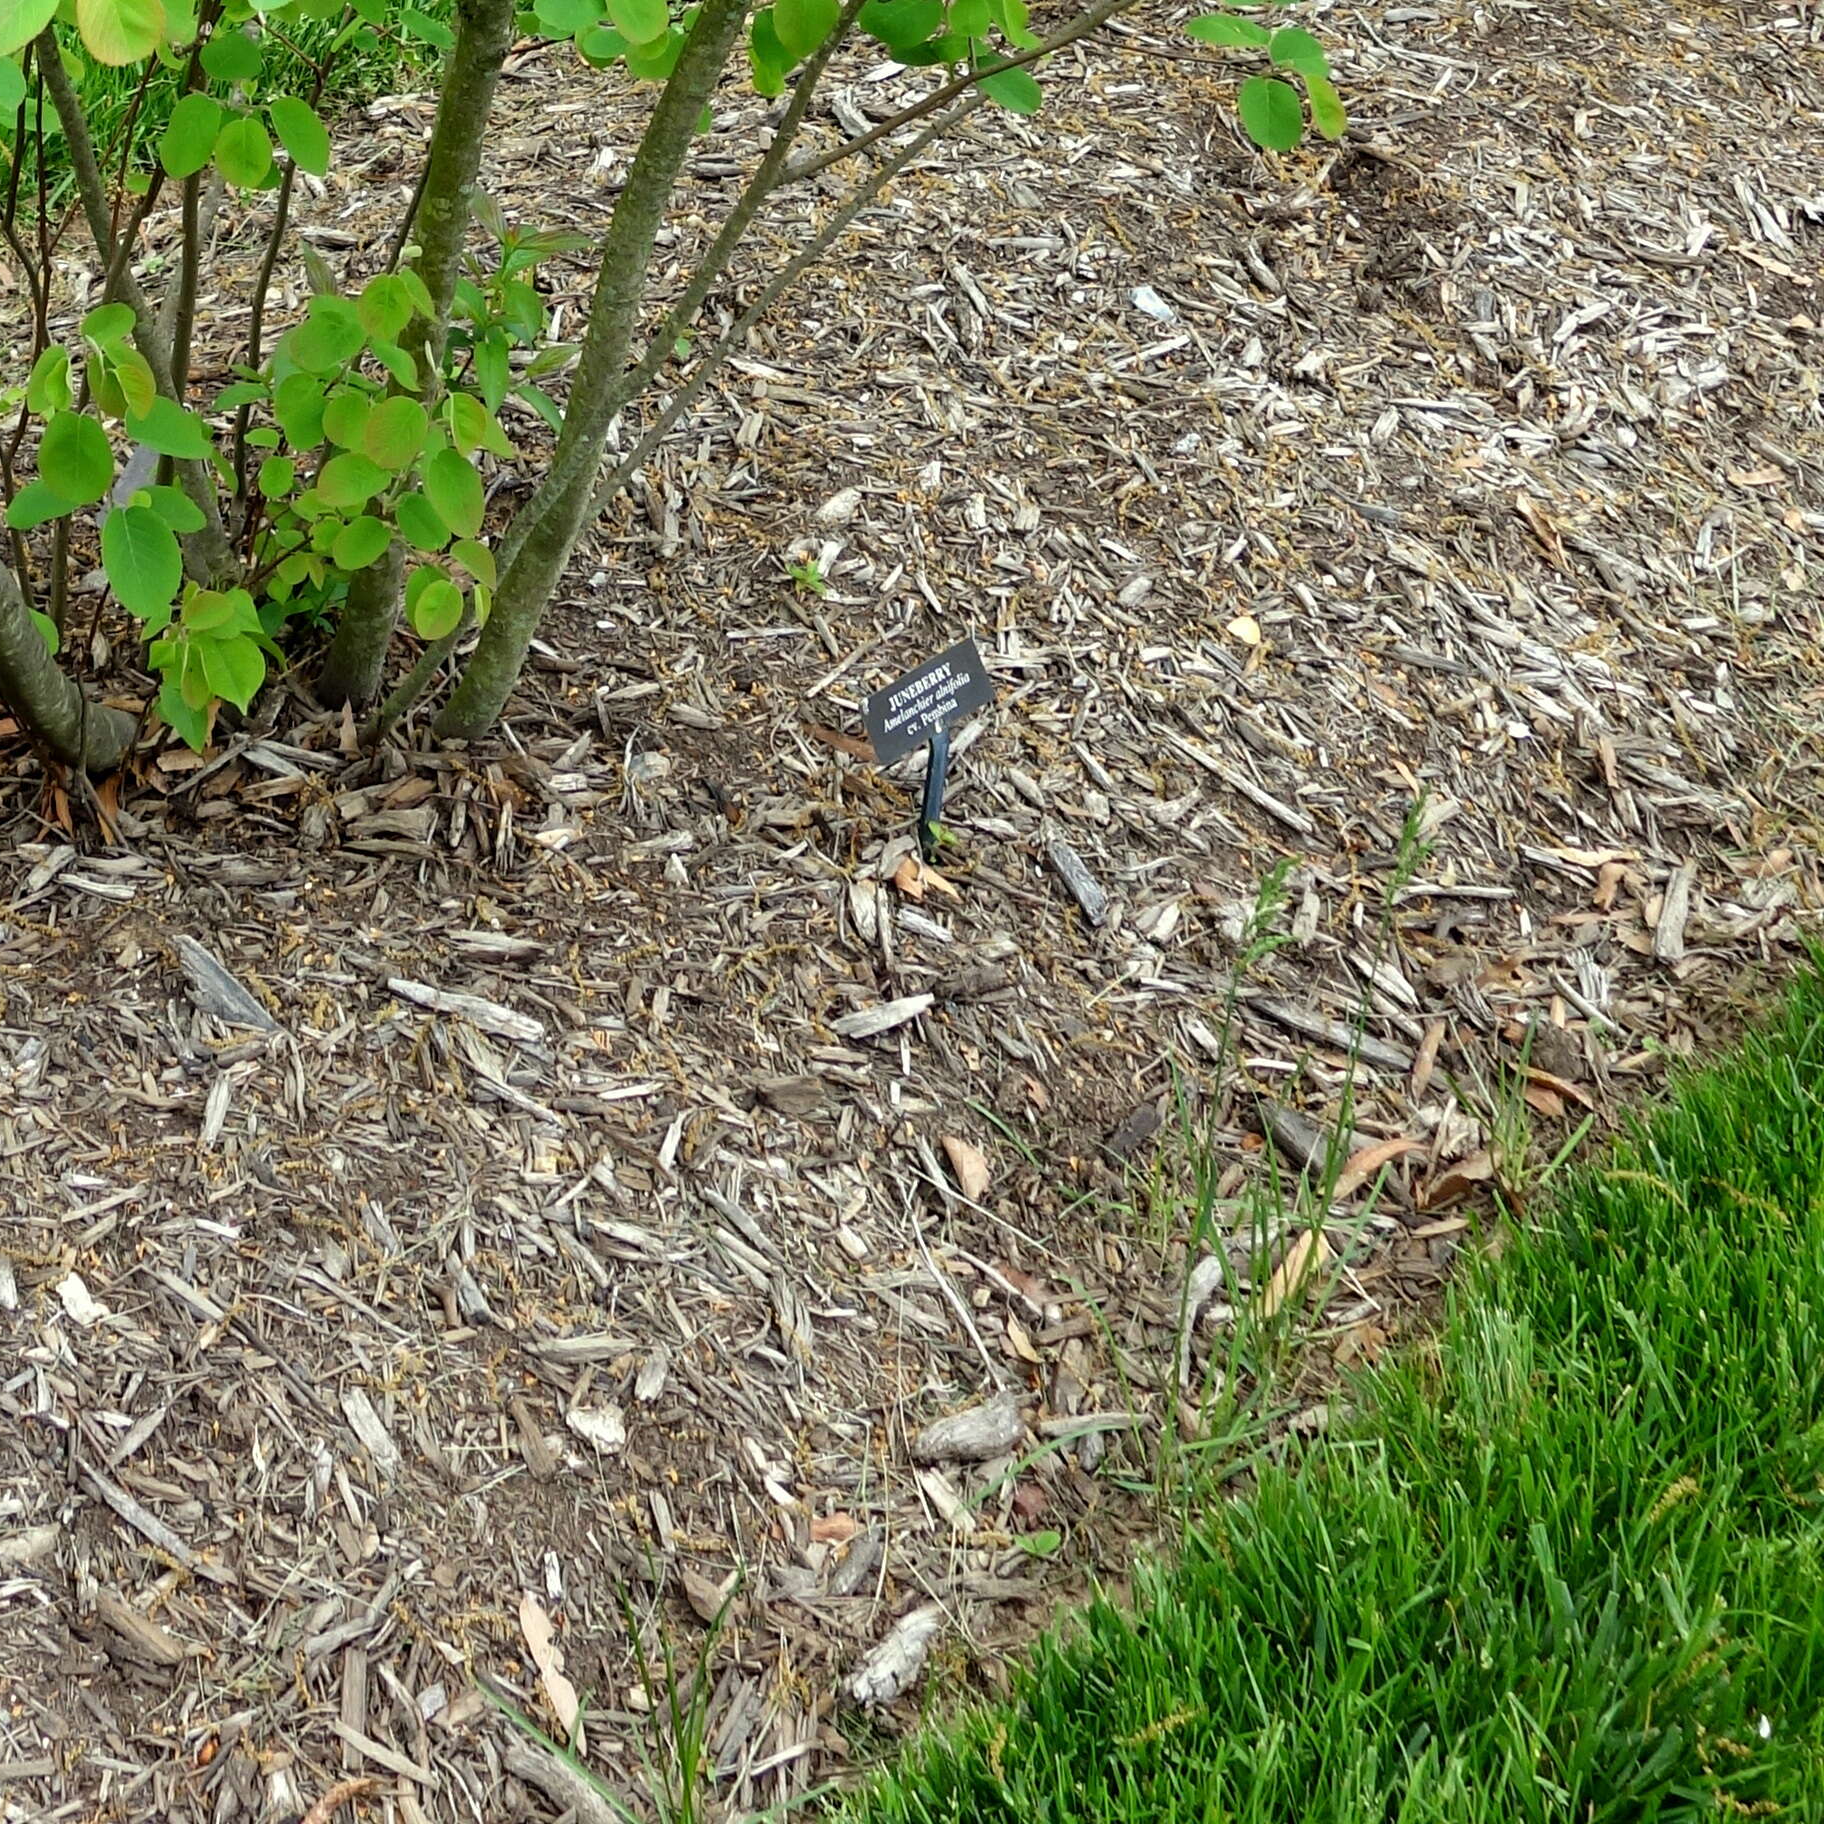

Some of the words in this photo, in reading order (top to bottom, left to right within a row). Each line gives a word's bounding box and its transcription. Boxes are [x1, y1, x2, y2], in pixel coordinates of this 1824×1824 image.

[884, 694, 934, 733] Amelanchier
[935, 672, 971, 700] alnifolia
[888, 662, 952, 712] JUNEBERRY
[906, 722, 921, 735] cv.
[920, 698, 958, 726] Pembina
